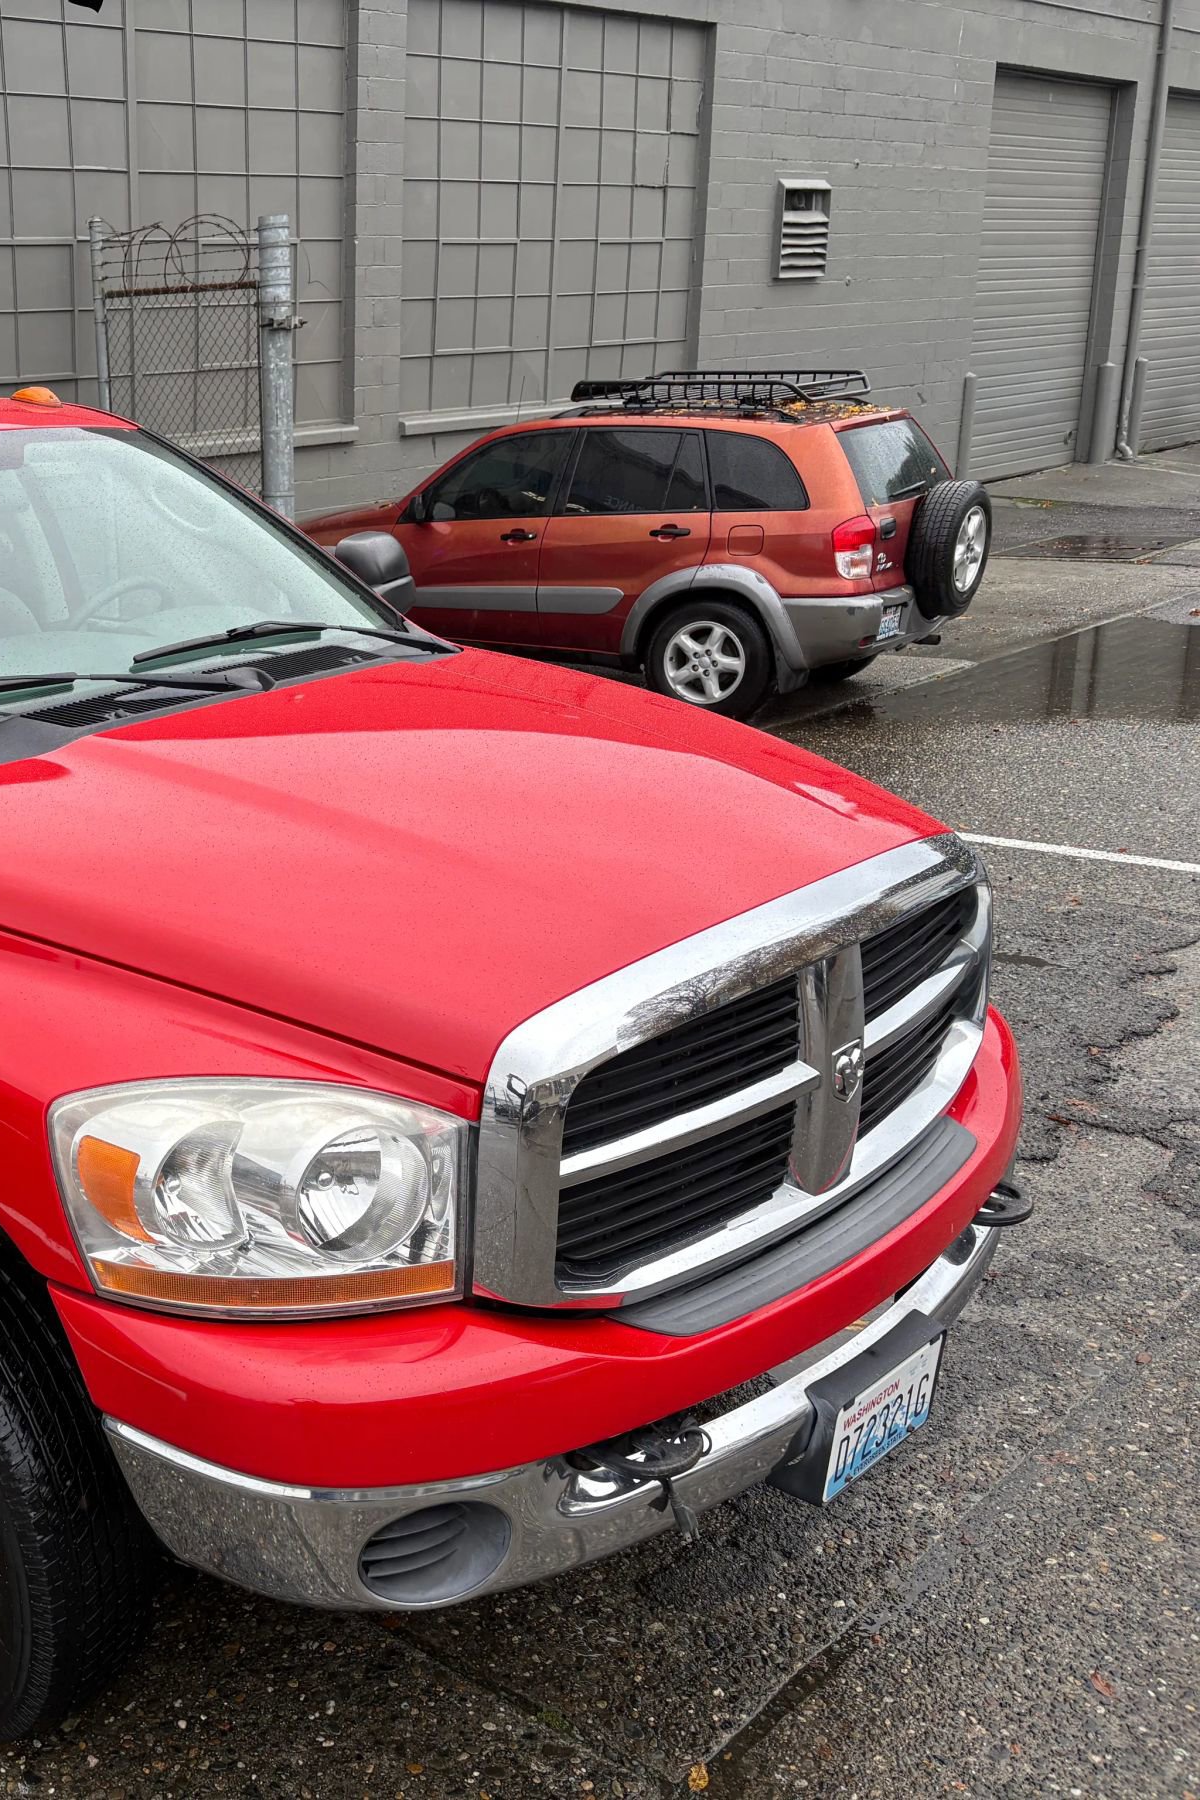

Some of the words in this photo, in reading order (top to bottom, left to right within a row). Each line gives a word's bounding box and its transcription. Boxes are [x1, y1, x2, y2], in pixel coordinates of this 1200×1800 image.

[843, 1379, 901, 1431] WASHINGTON
[853, 1446, 885, 1475] EVERGREEN
[886, 1431, 903, 1450] STATE
